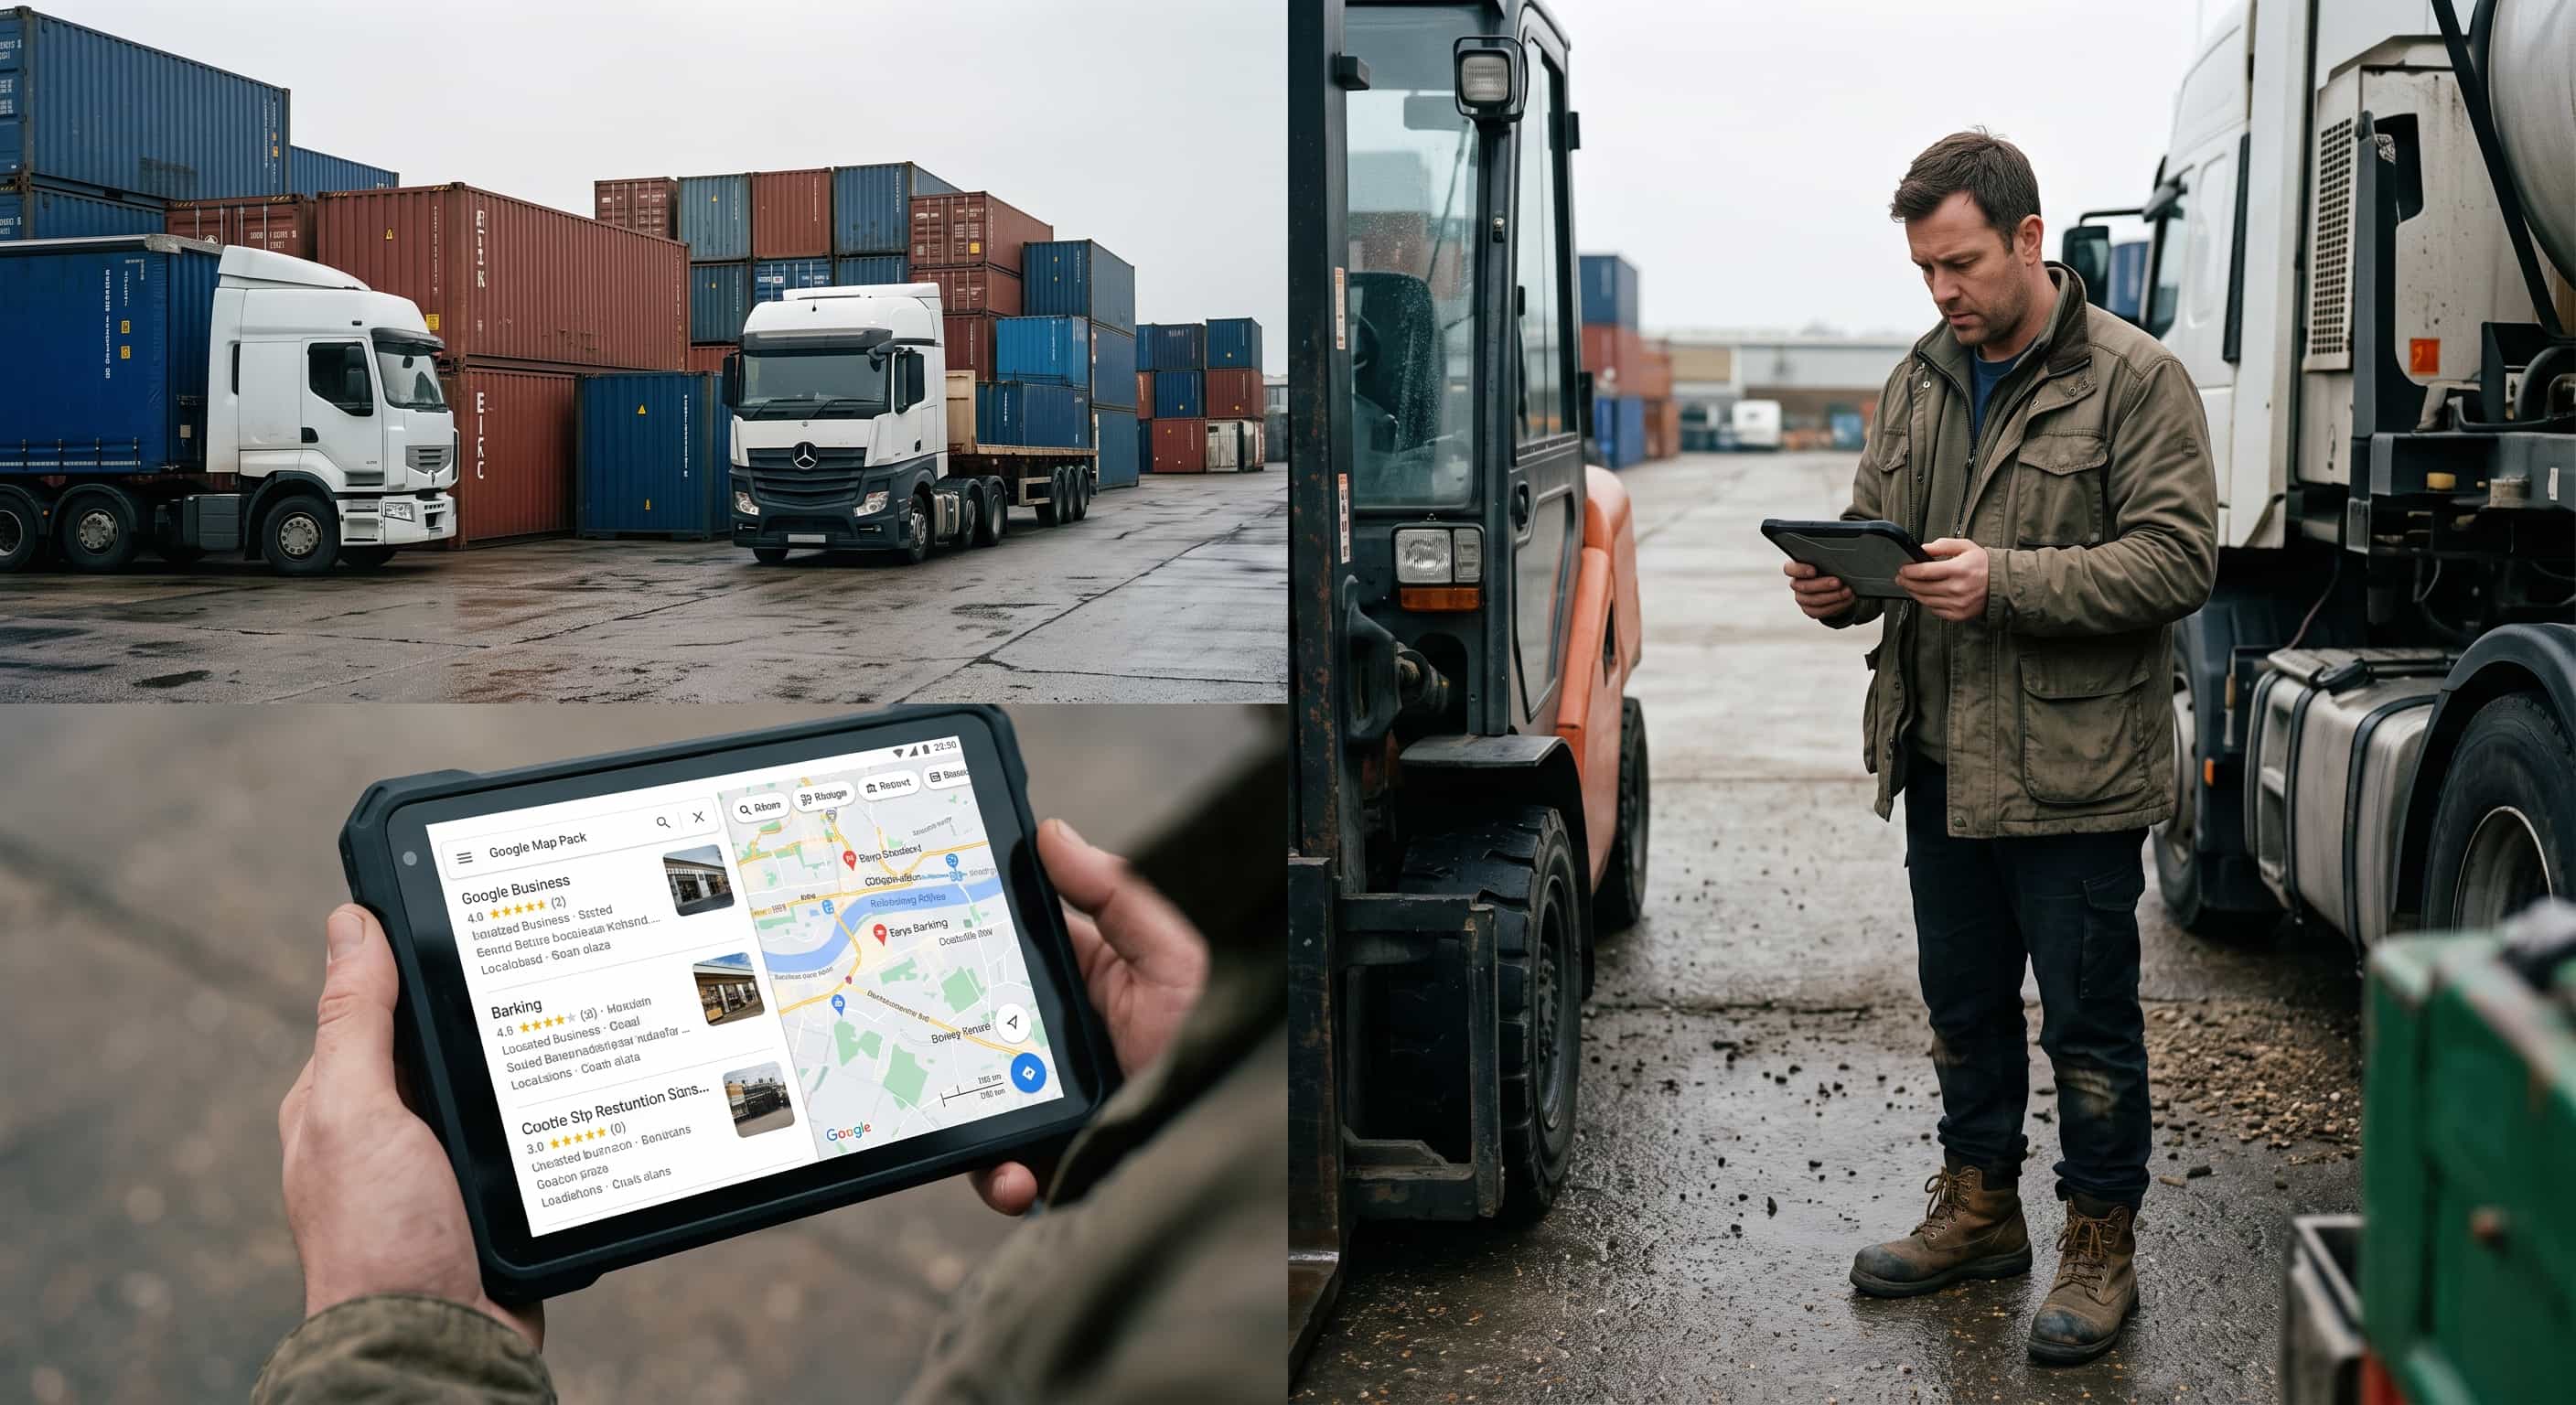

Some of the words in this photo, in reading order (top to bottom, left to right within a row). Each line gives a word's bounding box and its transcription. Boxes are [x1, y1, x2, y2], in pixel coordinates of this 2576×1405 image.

[489, 842, 530, 858] Google
[532, 837, 557, 851] Map
[559, 832, 587, 845] Pack
[461, 885, 510, 905] Google
[510, 875, 571, 896] Business
[467, 912, 484, 924] 4.0
[551, 896, 566, 910] (2)
[521, 915, 571, 931] Business
[913, 918, 949, 935] Barking
[490, 1000, 542, 1019] Barking
[553, 1026, 601, 1045] Business
[526, 1142, 544, 1154] 3.0
[610, 1121, 627, 1136] (0)
[826, 1120, 872, 1142] Google
